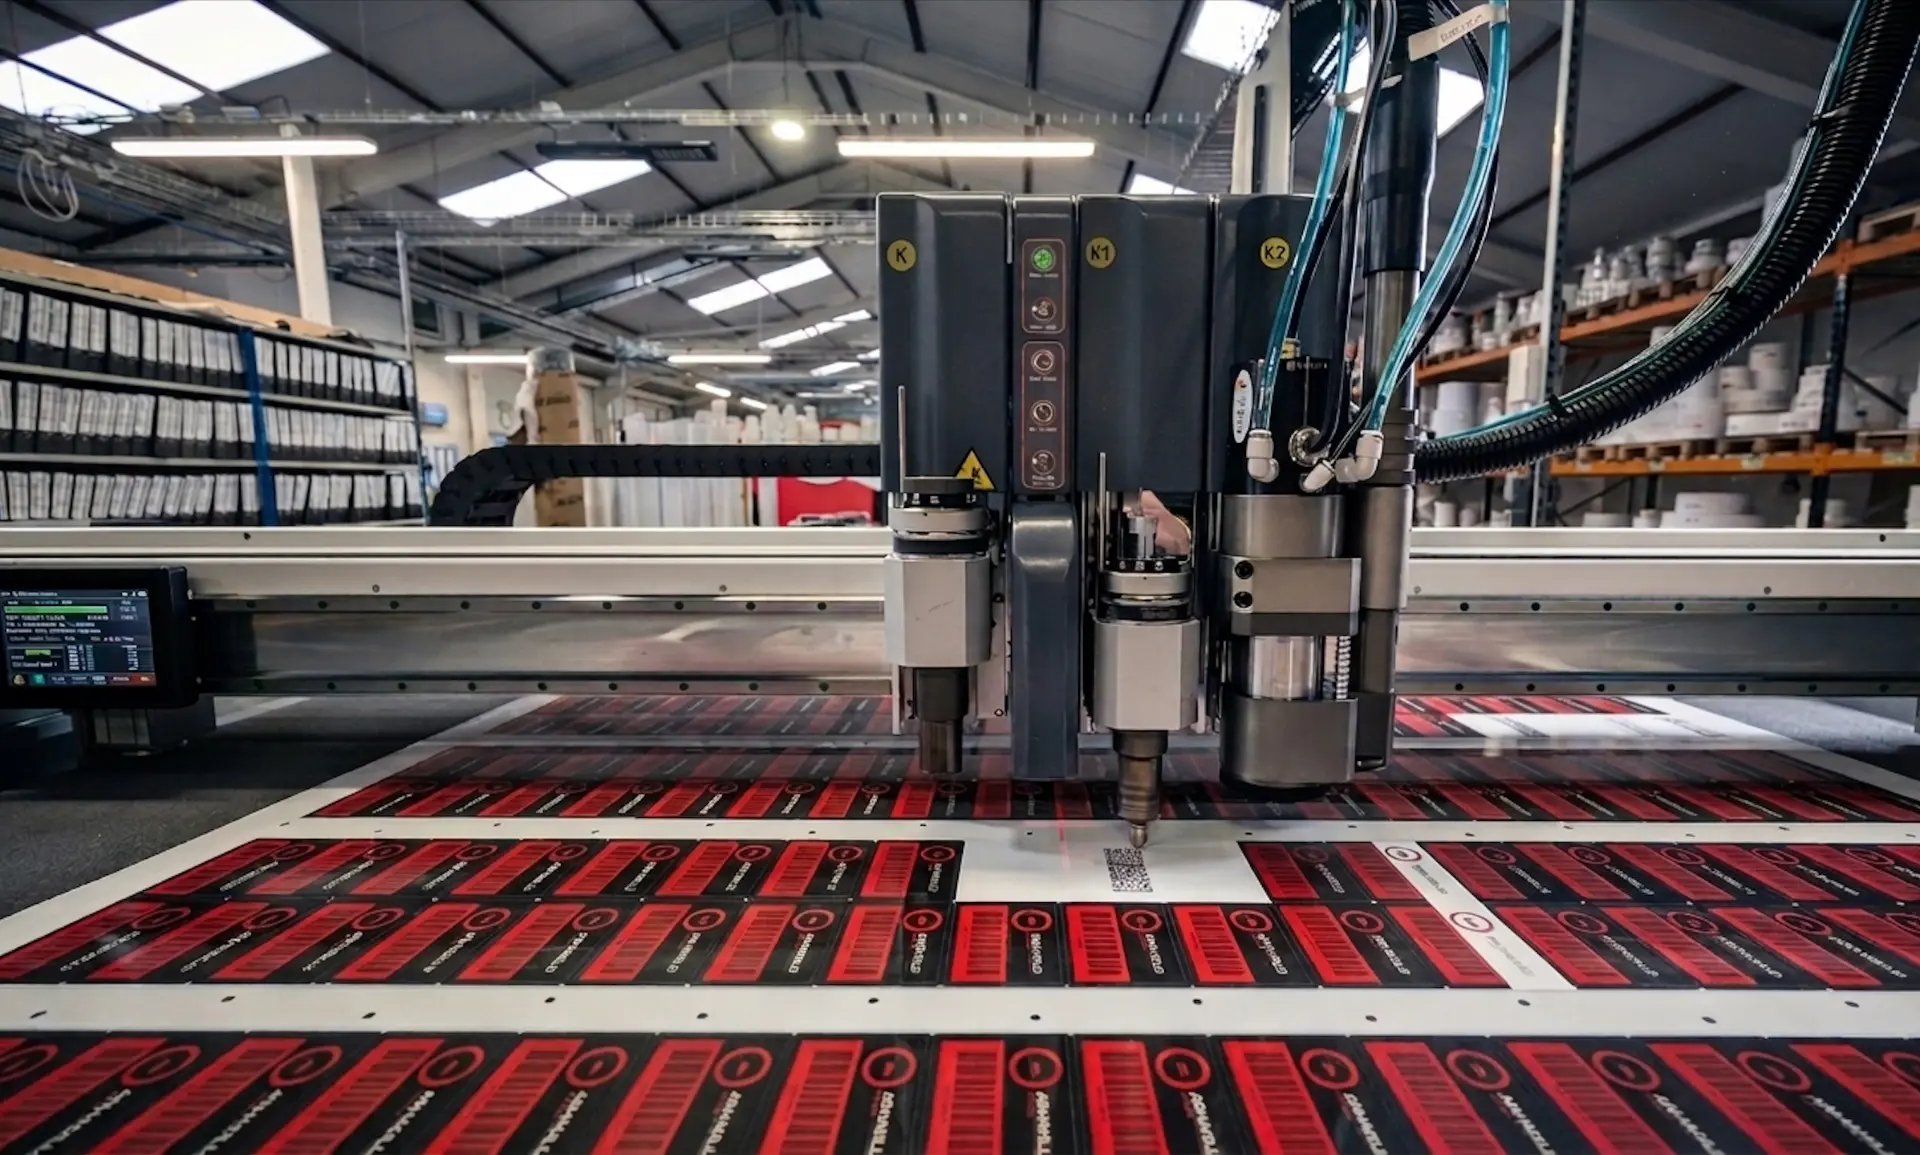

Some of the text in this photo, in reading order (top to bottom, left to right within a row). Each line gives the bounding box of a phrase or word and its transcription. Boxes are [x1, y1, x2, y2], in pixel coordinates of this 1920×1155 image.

[896, 247, 907, 264] K
[1091, 245, 1109, 260] K1
[1265, 246, 1286, 259] K2
